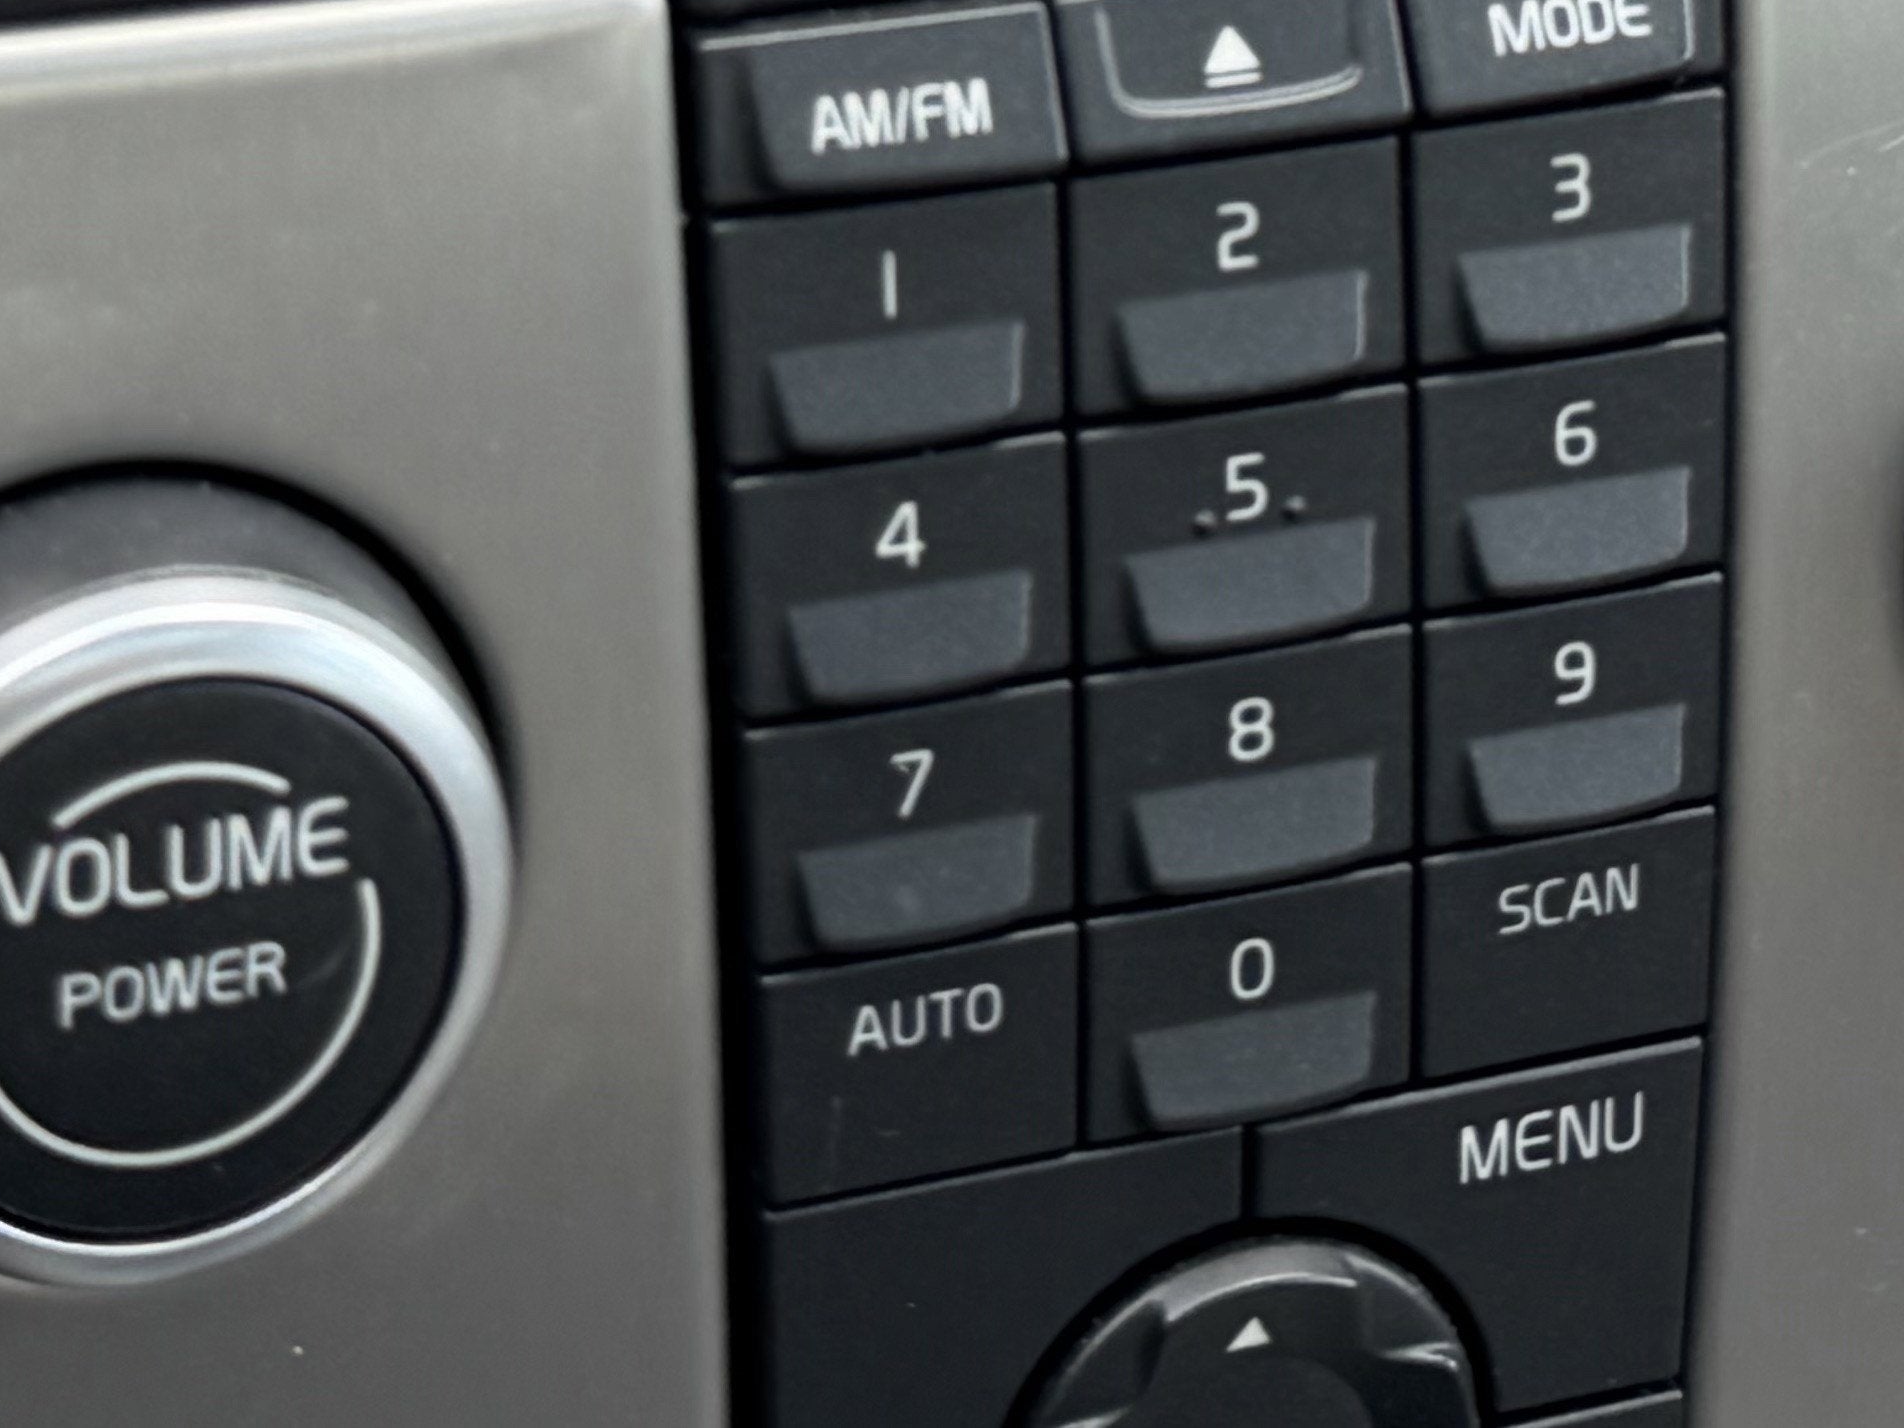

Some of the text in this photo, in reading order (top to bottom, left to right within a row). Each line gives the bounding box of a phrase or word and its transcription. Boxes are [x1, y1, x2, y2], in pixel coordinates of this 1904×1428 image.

[810, 76, 994, 156] AM/FM
[1549, 152, 1592, 223] 3
[1215, 200, 1260, 274] 2
[881, 249, 897, 320] 1
[1553, 399, 1598, 467] 6
[1224, 451, 1269, 522] 5
[874, 500, 926, 568] 4
[1553, 640, 1598, 706] 9
[1227, 696, 1275, 762] 8
[888, 748, 935, 818] 7
[1497, 861, 1641, 936] SCAN
[57, 940, 288, 1032] POWER
[1228, 937, 1276, 1001] 0
[846, 982, 1005, 1058] AUTO
[1457, 1091, 1645, 1186] MENU
